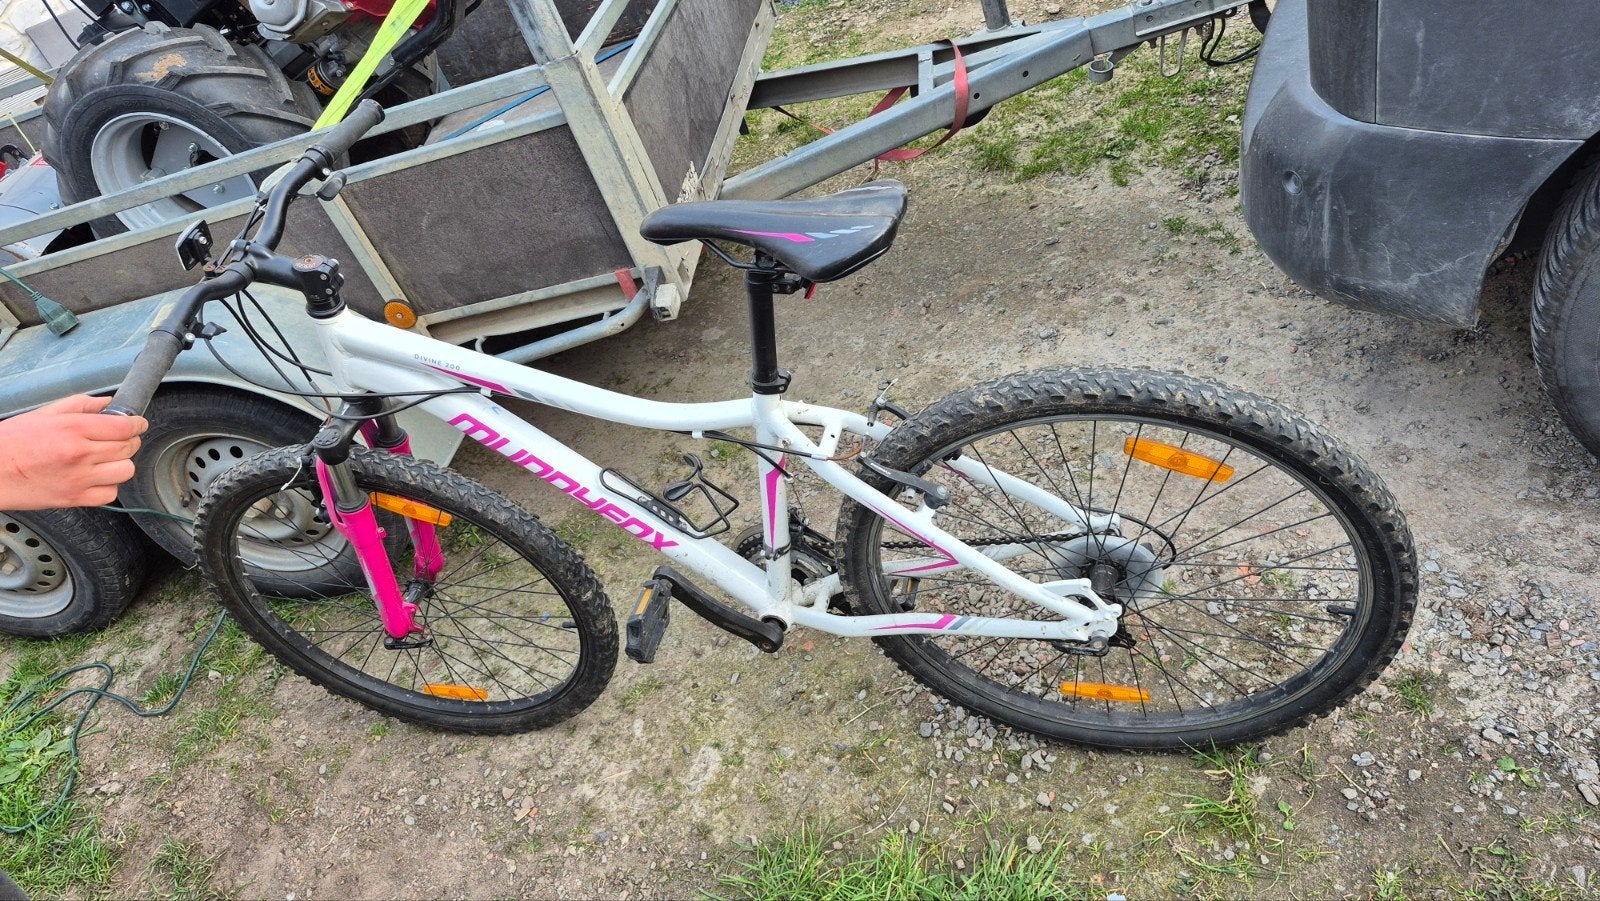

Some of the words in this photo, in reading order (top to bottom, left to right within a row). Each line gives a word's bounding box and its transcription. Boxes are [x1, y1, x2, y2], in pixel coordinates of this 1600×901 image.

[414, 353, 442, 366] DIVINE
[445, 362, 461, 371] 200
[447, 412, 679, 551] MUDDYFOX
